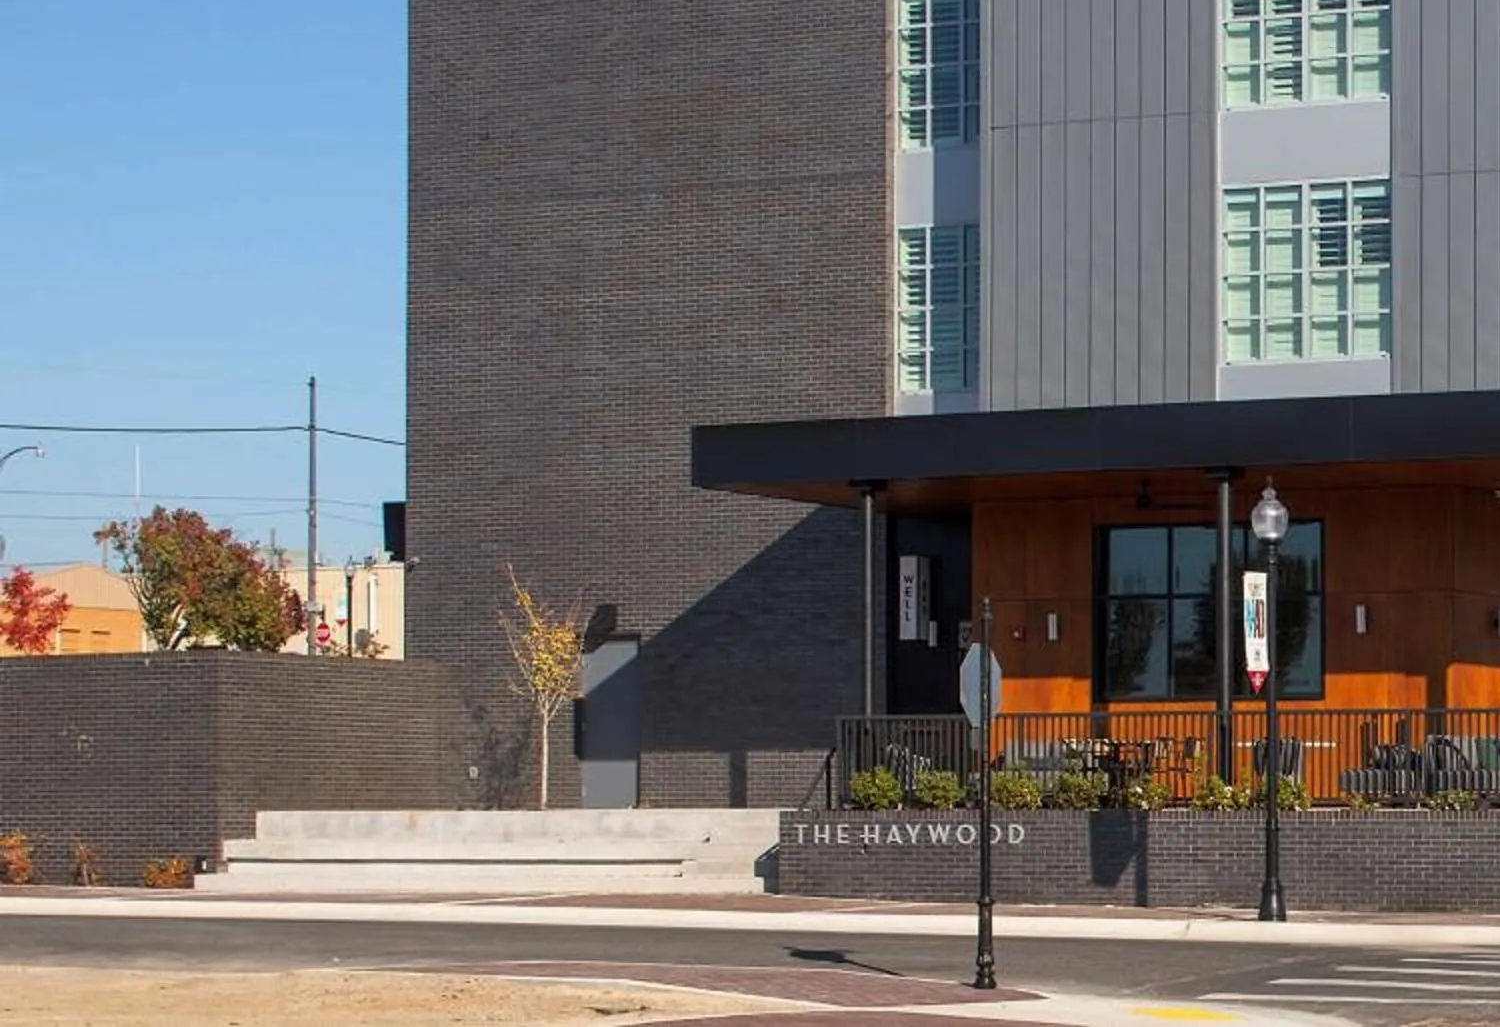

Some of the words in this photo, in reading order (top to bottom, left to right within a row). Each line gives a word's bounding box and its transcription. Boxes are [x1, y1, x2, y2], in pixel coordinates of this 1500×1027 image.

[903, 575, 914, 622] WELL
[792, 824, 849, 844] THE
[860, 823, 1025, 845] HAYWOOD
